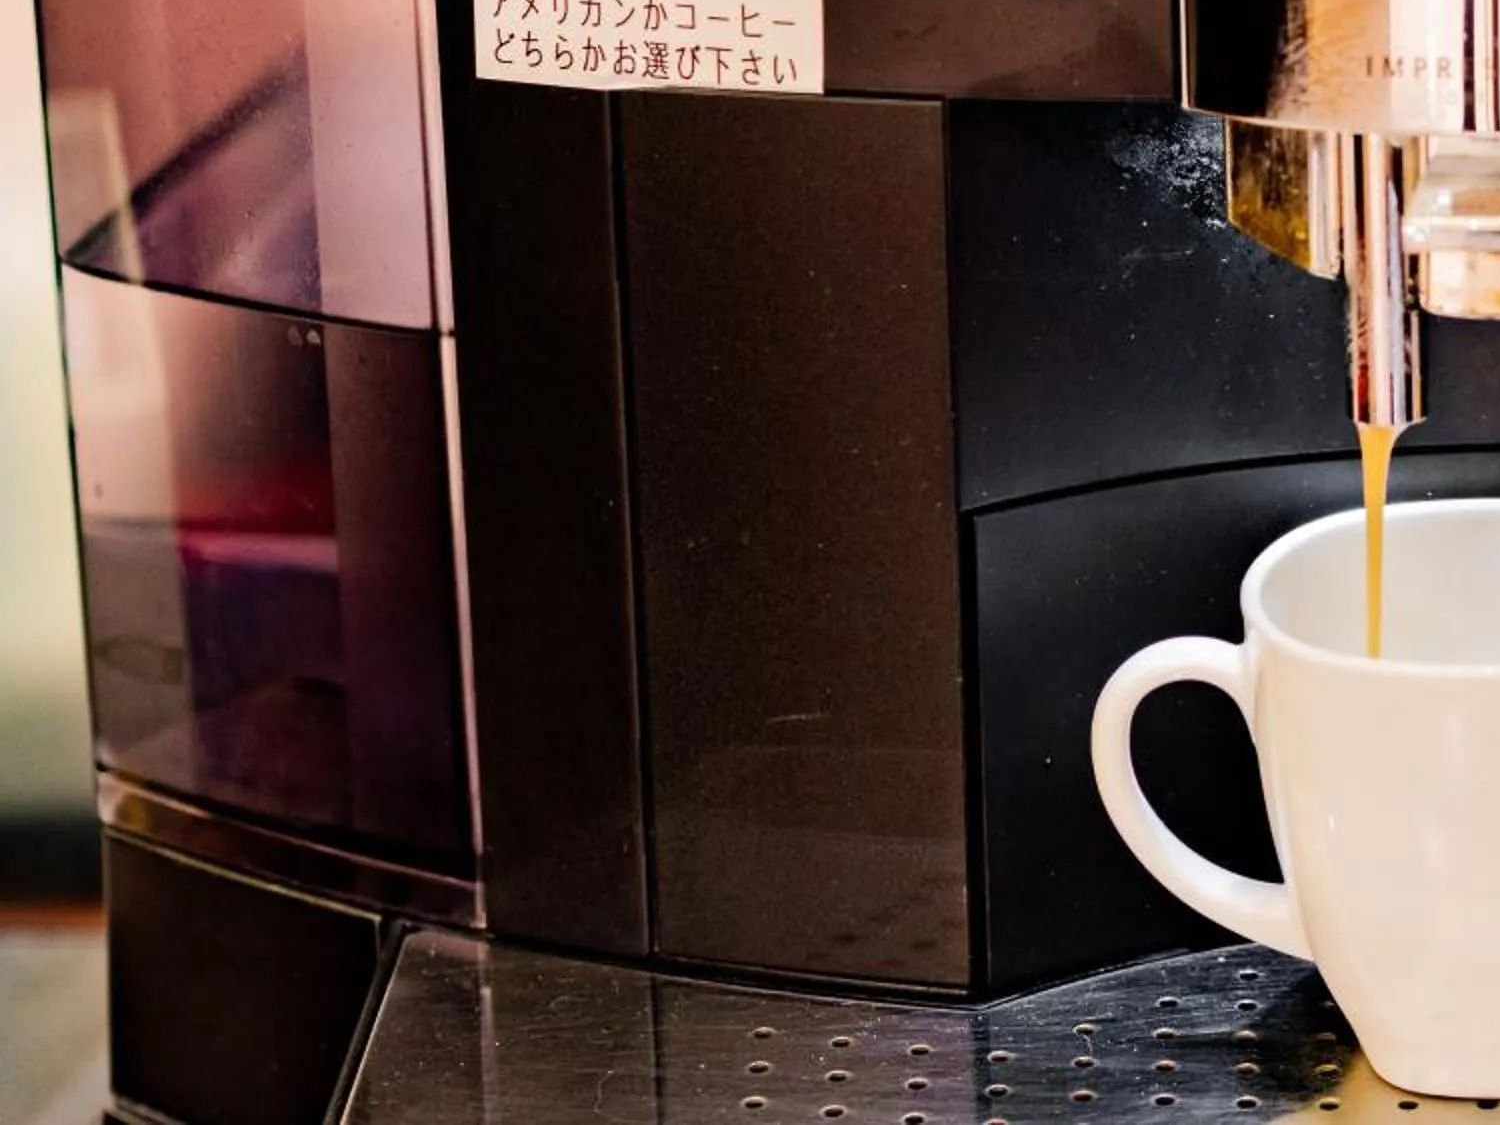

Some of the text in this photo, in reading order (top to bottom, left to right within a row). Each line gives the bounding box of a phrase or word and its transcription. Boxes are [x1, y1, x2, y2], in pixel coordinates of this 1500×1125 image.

[493, 29, 798, 85] どちらかお選び下さい
